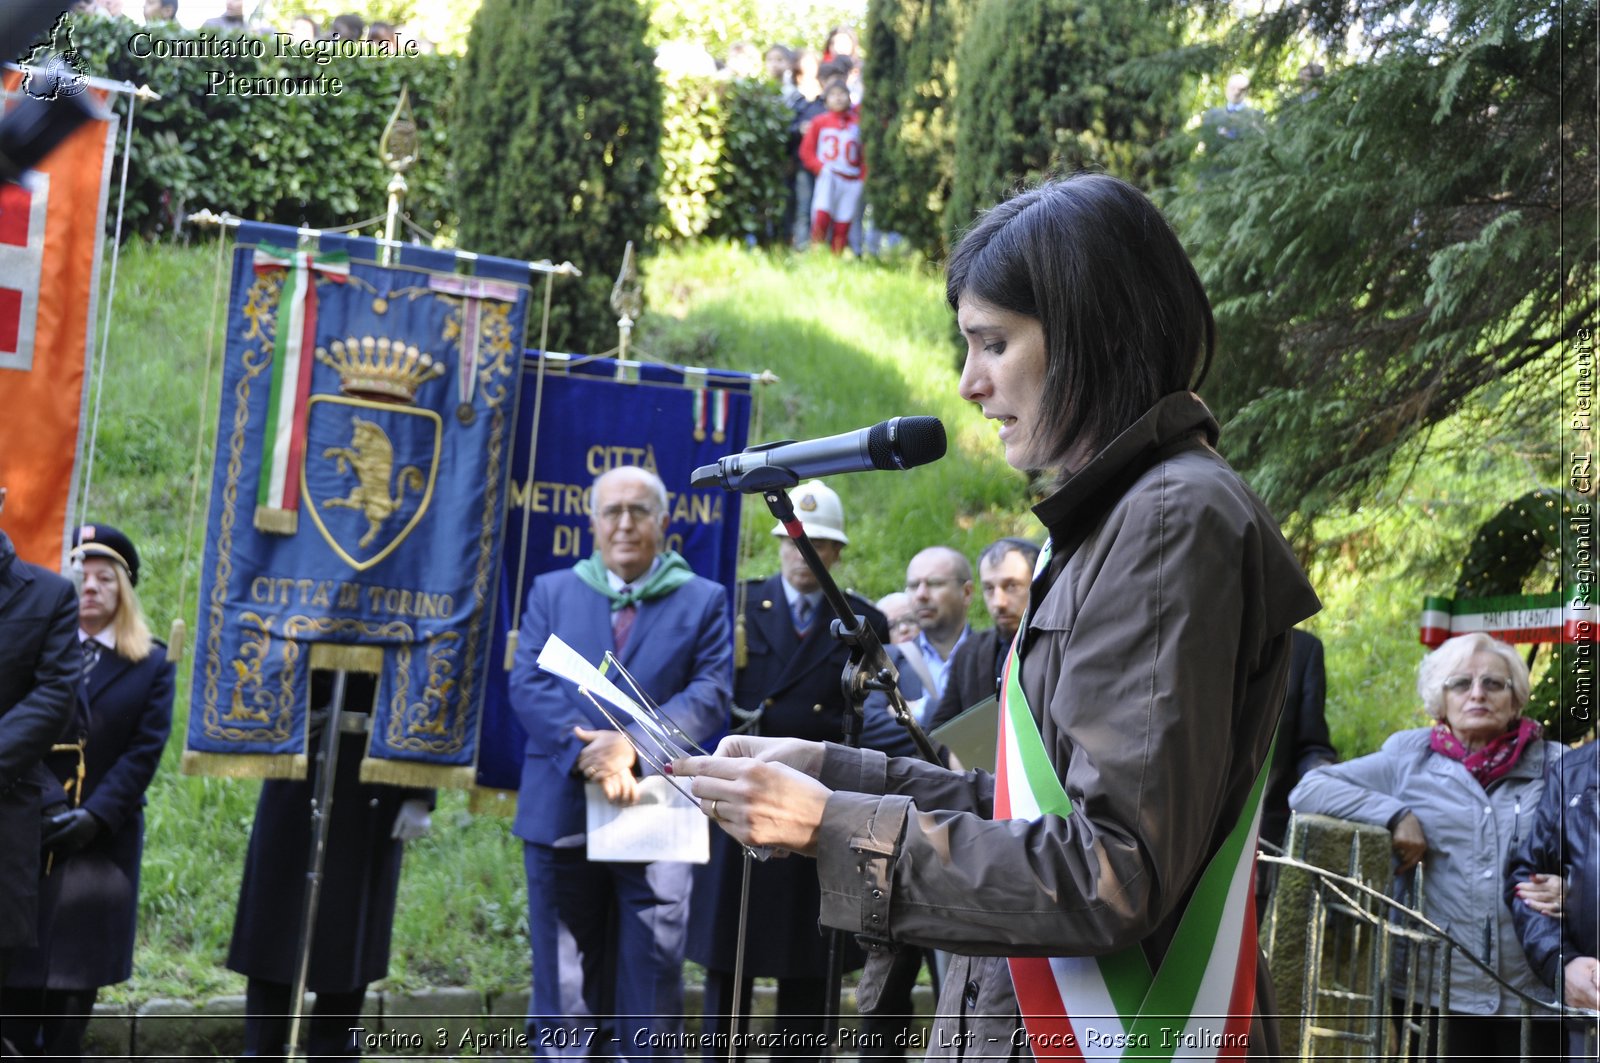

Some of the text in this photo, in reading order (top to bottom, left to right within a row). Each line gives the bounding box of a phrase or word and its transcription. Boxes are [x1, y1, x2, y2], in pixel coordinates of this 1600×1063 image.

[823, 135, 862, 168] 30
[552, 524, 580, 558] DI
[337, 582, 361, 609] DI
[367, 586, 454, 618] TORINO
